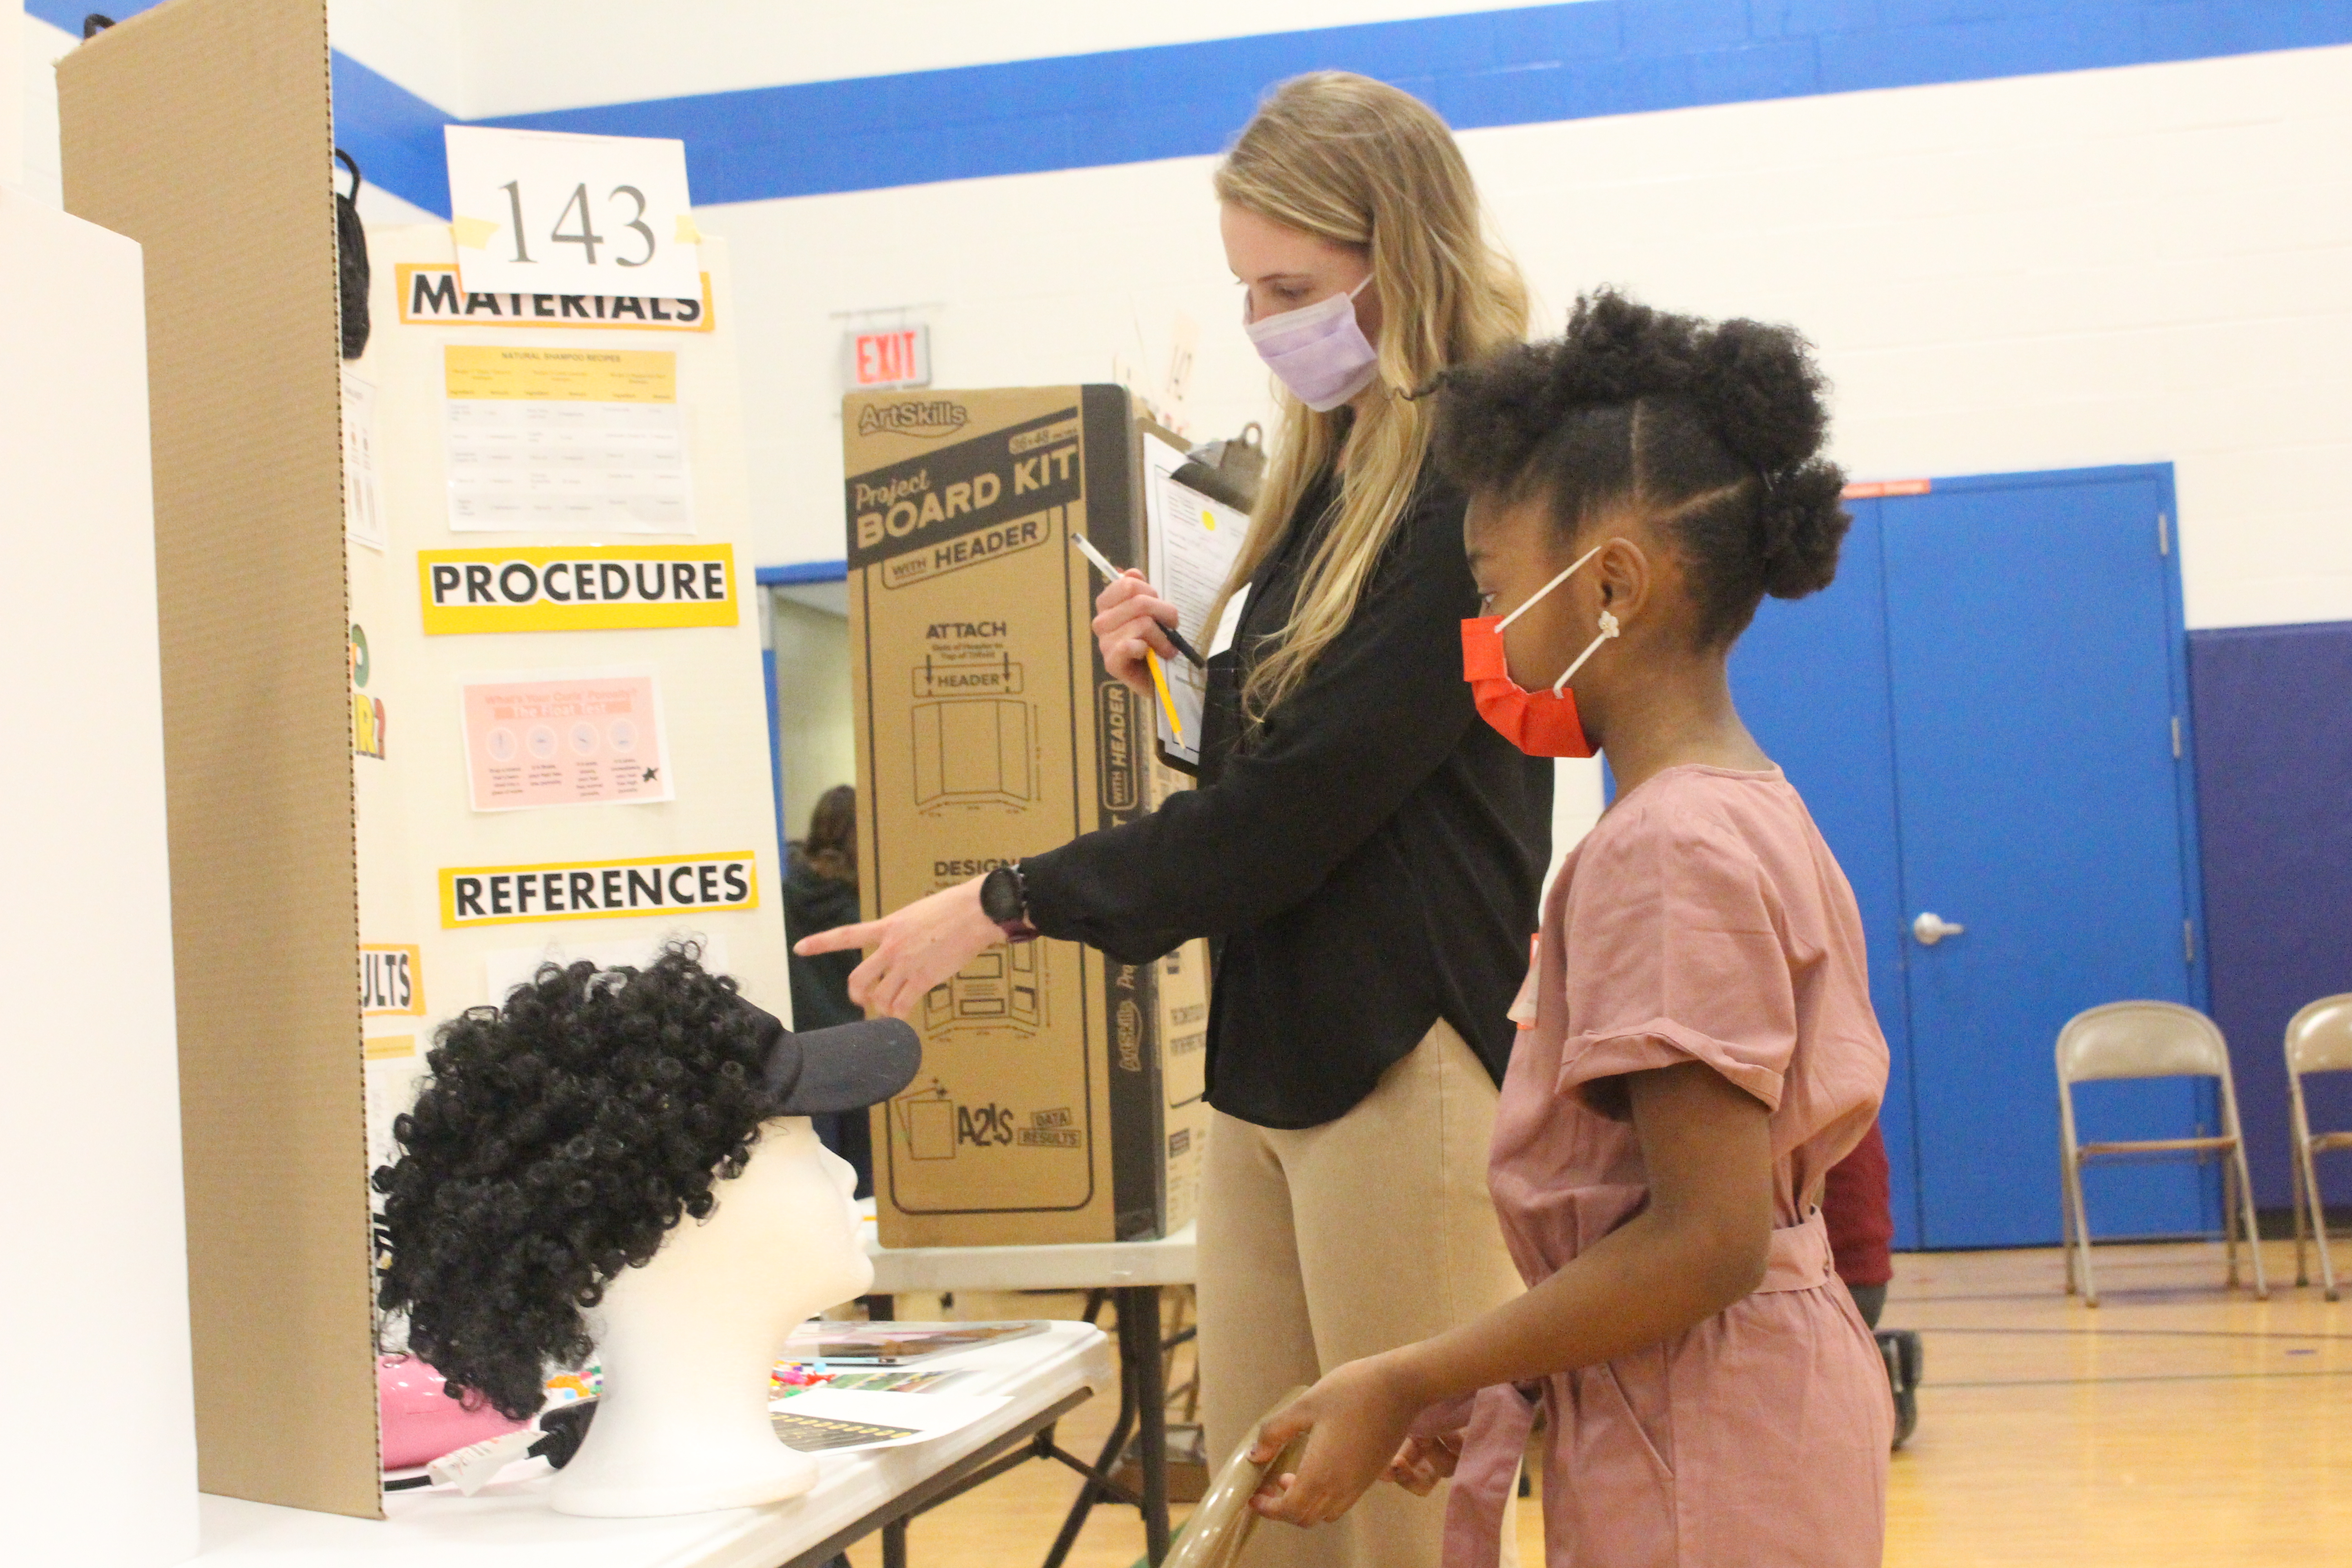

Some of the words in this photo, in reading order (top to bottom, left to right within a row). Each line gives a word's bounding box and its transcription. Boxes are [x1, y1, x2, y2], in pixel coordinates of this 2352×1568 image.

[498, 179, 656, 267] 143
[412, 274, 700, 322] MATERIALS
[856, 331, 916, 385] EXIT
[858, 402, 967, 429] ArtSkills
[856, 469, 929, 510] Project
[857, 473, 1001, 549] BOARD
[1014, 445, 1077, 495] KIT
[935, 521, 1038, 570] HEADER
[432, 563, 725, 603] PROCEDURE
[926, 620, 1007, 639] ATTACH
[937, 673, 1000, 687] HEADER
[1109, 686, 1128, 768] HEADER
[456, 863, 748, 916] REFERENCES
